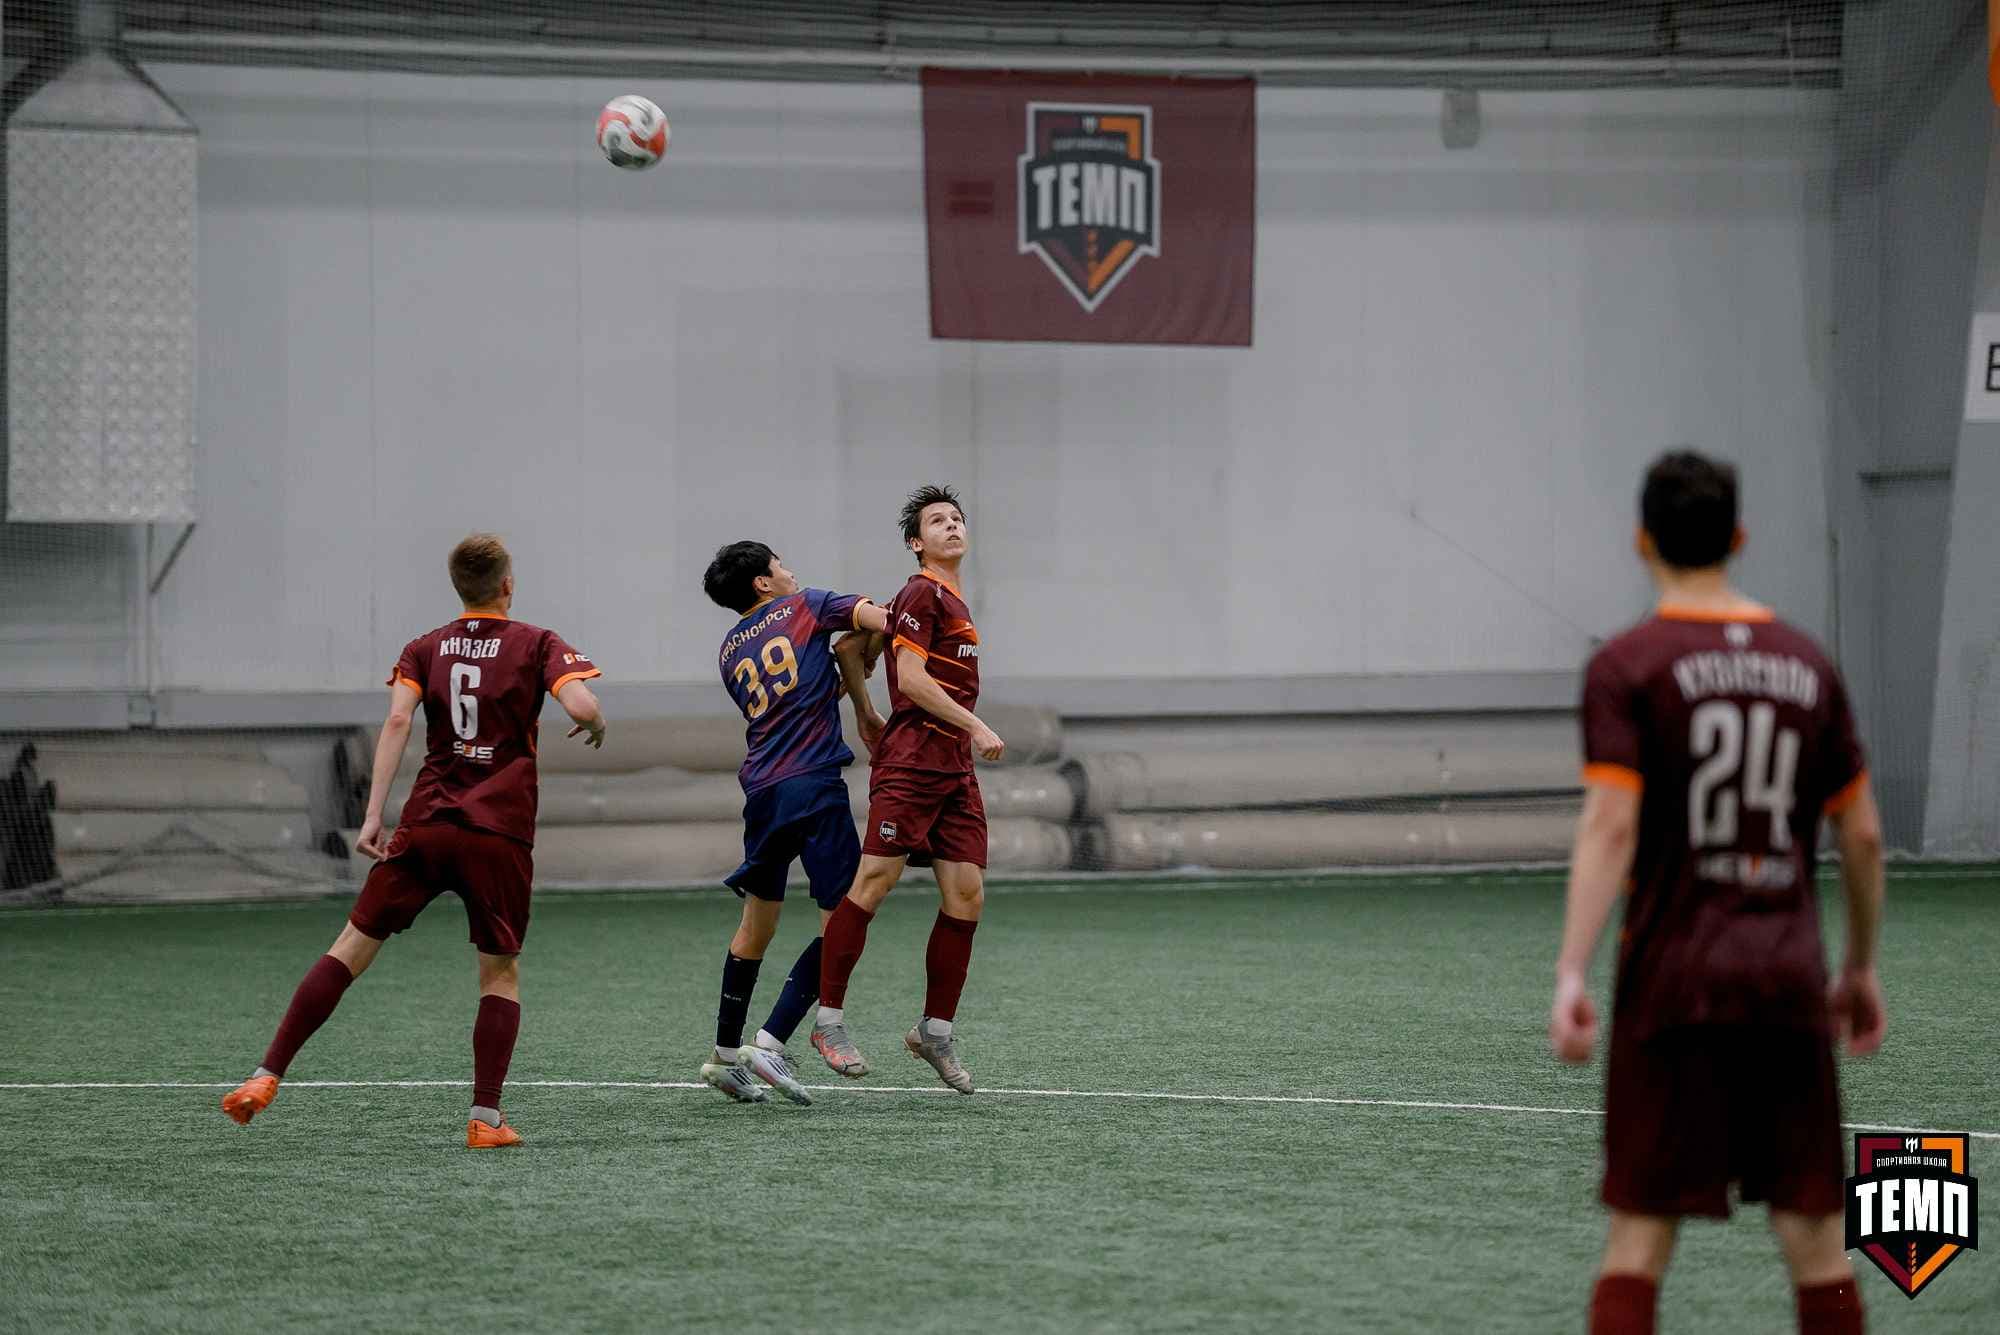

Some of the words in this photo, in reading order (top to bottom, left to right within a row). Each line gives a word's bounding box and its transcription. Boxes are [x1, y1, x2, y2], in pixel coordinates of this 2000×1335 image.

[1033, 162, 1147, 234] ТЕМП
[439, 636, 501, 659] КНЯЗЕВ
[735, 635, 799, 719] 39
[450, 662, 481, 740] 6
[1688, 699, 1801, 850] 24
